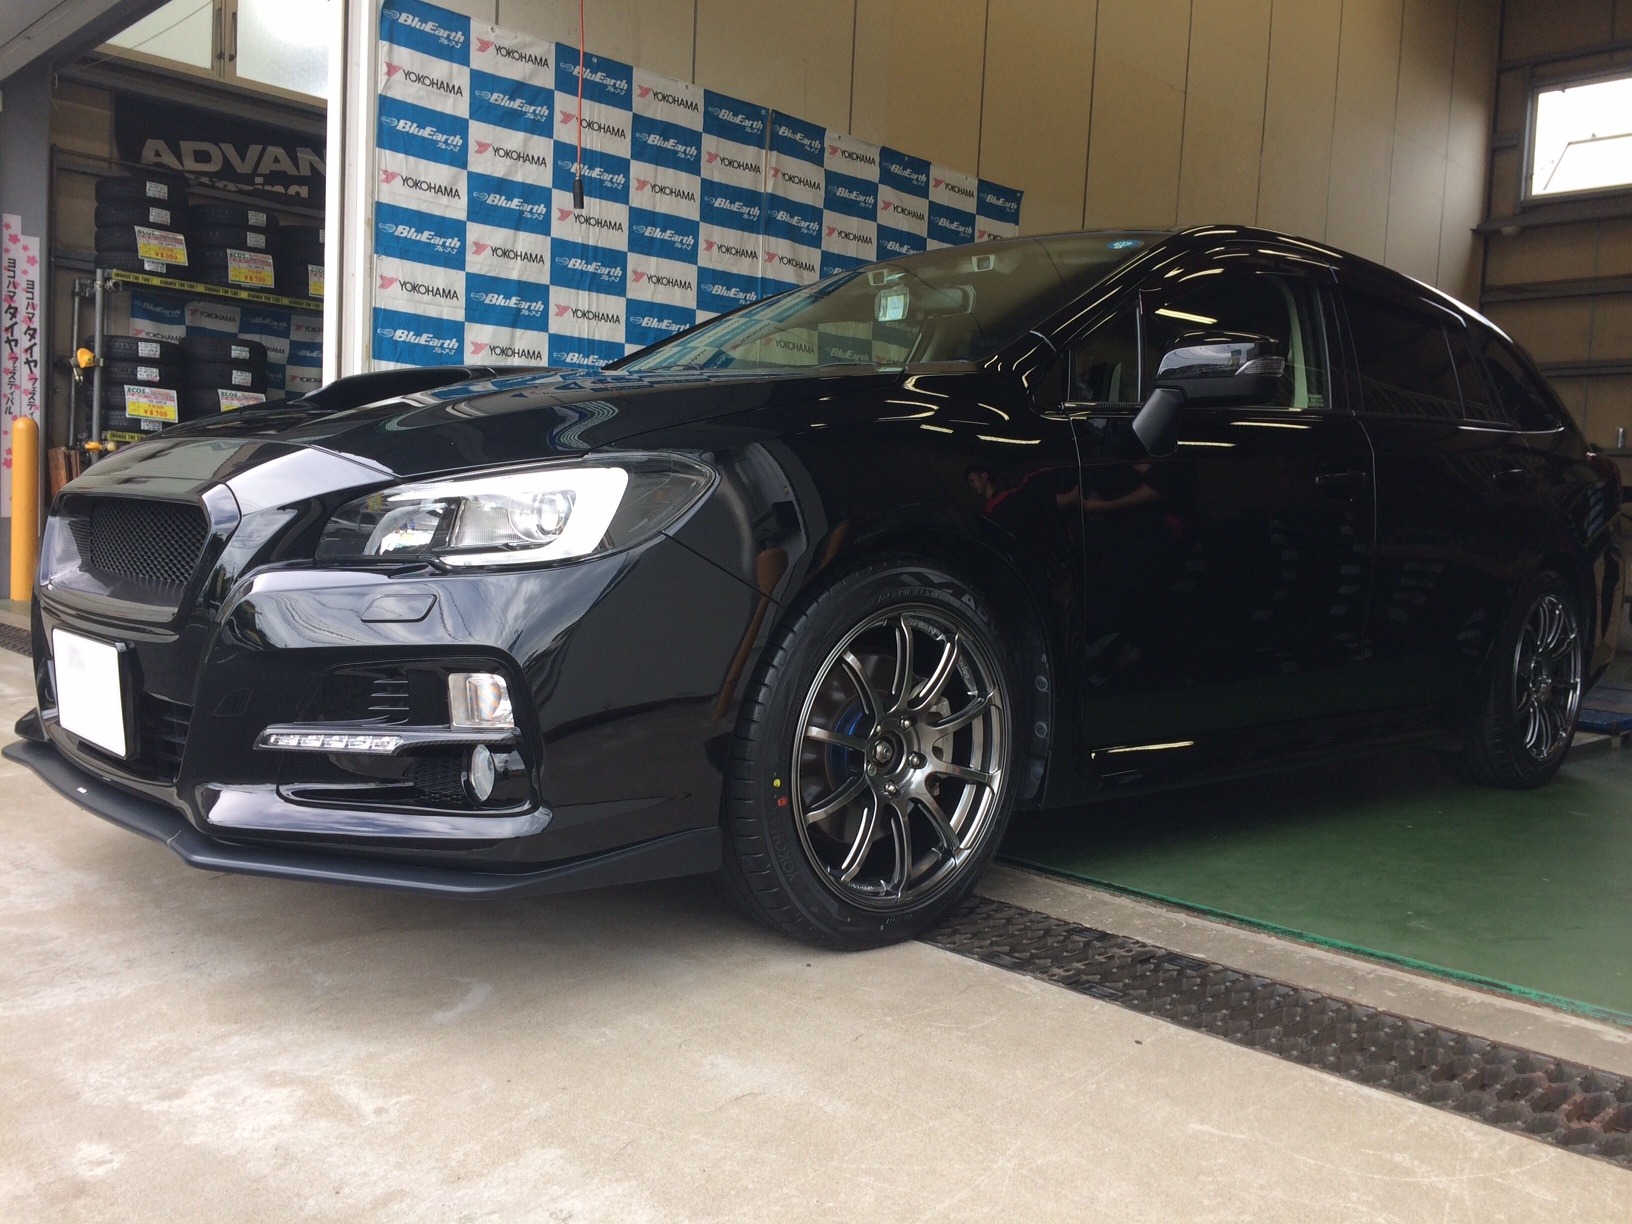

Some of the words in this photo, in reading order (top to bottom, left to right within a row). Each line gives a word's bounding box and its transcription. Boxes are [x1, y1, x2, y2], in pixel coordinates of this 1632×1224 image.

[398, 12, 464, 43] BluEarth
[494, 44, 549, 68] YOKOHAMA
[403, 69, 463, 97] YOKOHAMA
[489, 93, 549, 117] BluEarth
[652, 91, 699, 112] YOKOHAMA
[719, 109, 763, 130] BluEarth
[396, 120, 463, 146] BluEarth
[778, 127, 821, 149] BluEarth
[647, 134, 697, 155] BluEarth
[140, 138, 325, 176] ADVAN
[492, 146, 547, 168] YOKOHAMA
[719, 156, 761, 175] YOKOHAMA
[840, 149, 876, 167] YOKOHAMA
[781, 172, 821, 192] YOKOHAMA
[891, 164, 927, 183] BluEarth
[400, 175, 461, 200] YOKOHAMA
[650, 183, 696, 202] YOKOHAMA
[836, 187, 875, 206] BluEarth
[944, 182, 975, 200] YOKOHAMA
[486, 194, 546, 215] BluEarth
[714, 197, 760, 217] BluEarth
[893, 203, 925, 222] YOKOHAMA
[573, 212, 623, 233] YOKOHAMA
[776, 211, 820, 231] BluEarth
[939, 217, 973, 234] BluEarth
[395, 224, 461, 249] BluEarth
[644, 226, 695, 245] BluEarth
[836, 229, 873, 246] YOKOHAMA
[490, 245, 545, 265] YOKOHAMA
[717, 244, 758, 261] YOKOHAMA
[567, 258, 623, 277] BluEarth
[778, 256, 816, 274] YOKOHAMA
[398, 279, 459, 301] YOKOHAMA
[646, 273, 693, 291] YOKOHAMA
[484, 293, 545, 312] BluEarth
[712, 284, 757, 301] BluEarth
[199, 311, 237, 323] YOKOHAMA
[571, 308, 621, 325] YOKOHAMA
[393, 329, 460, 349] BluEarth
[775, 339, 815, 355] YOKOHAMA
[489, 344, 543, 362] YOKOHAMA
